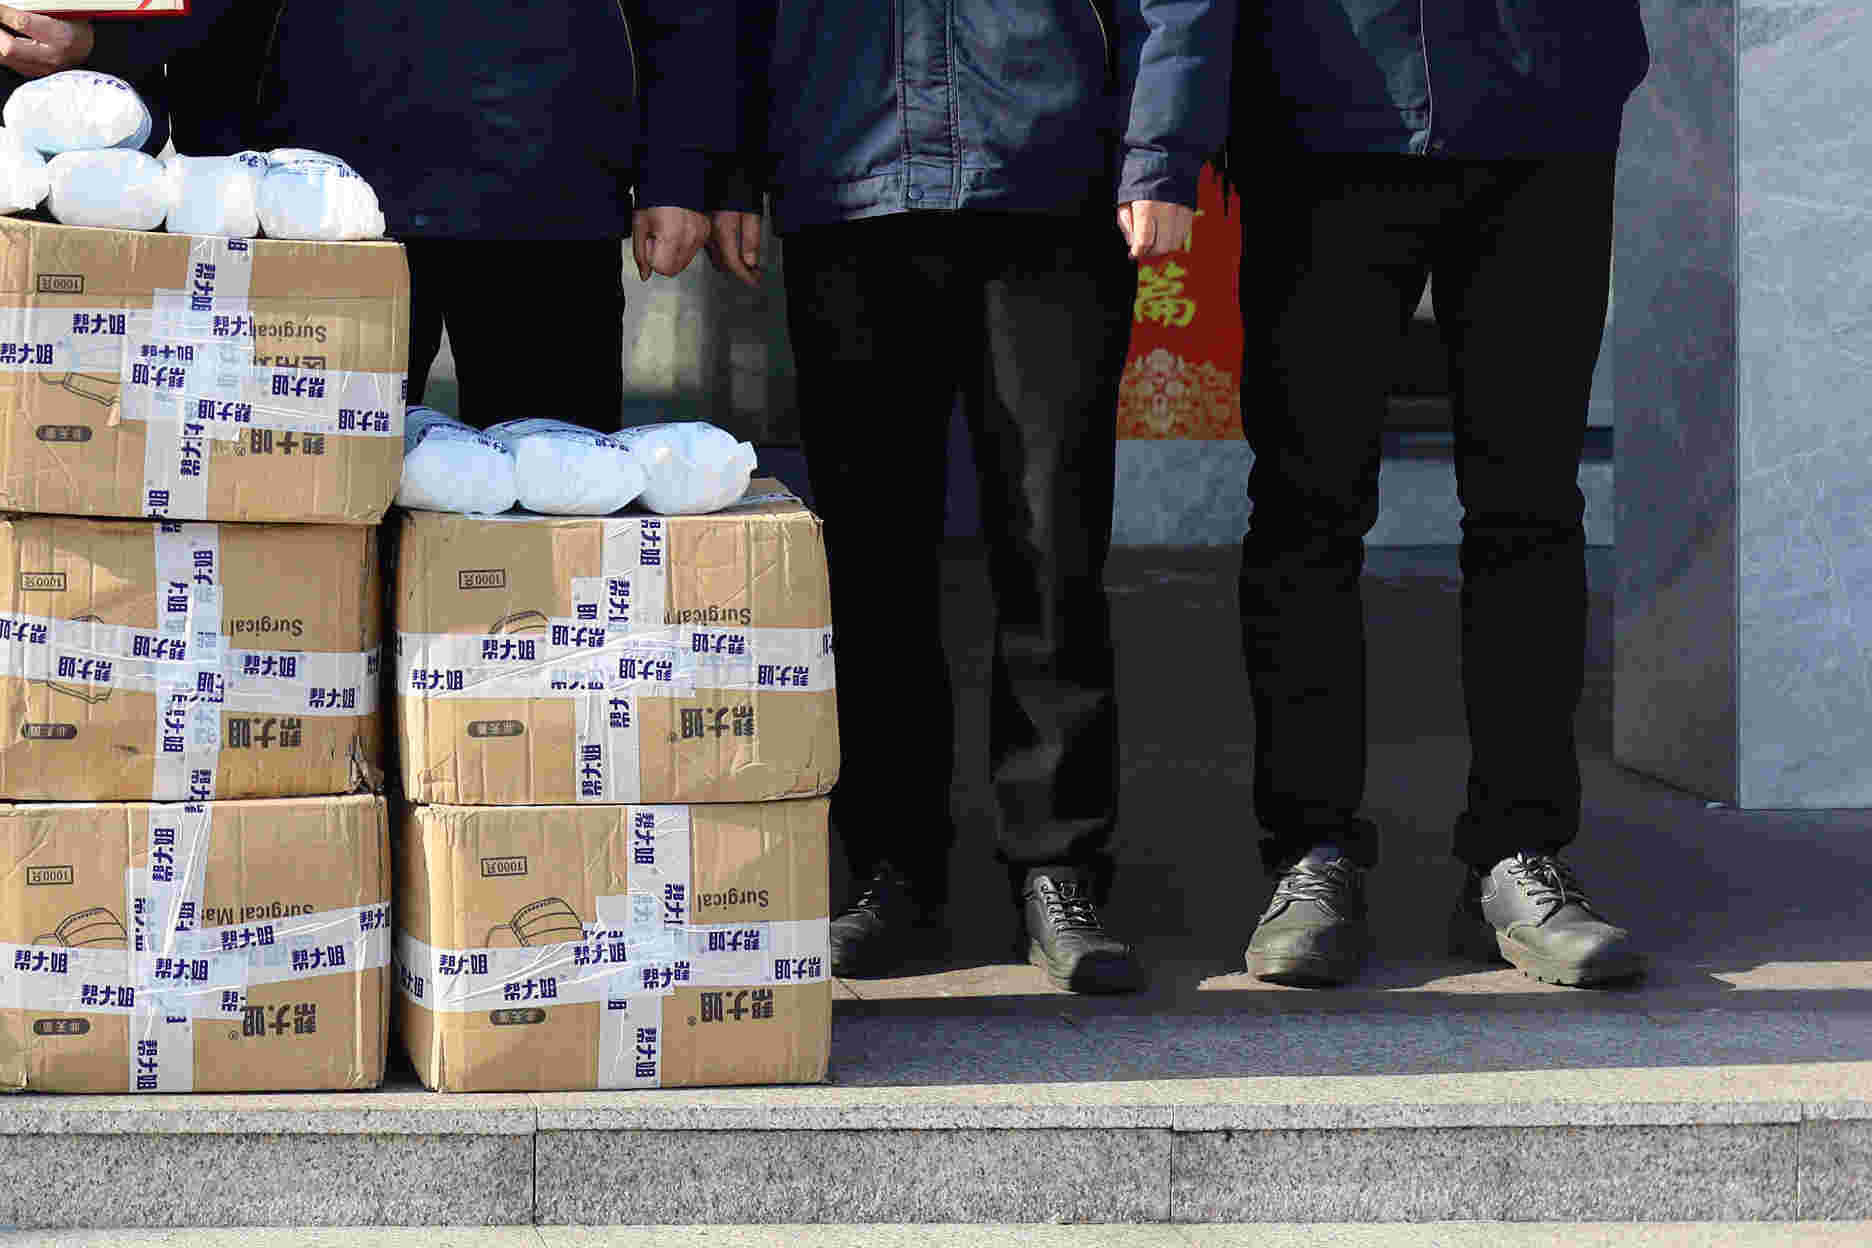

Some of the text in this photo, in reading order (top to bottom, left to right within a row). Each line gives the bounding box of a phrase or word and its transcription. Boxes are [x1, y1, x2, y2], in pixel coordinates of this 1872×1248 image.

[1133, 260, 1196, 328] 篇
[73, 314, 125, 335] 帮大姐
[0, 344, 53, 365] 帮大姐
[272, 374, 325, 397] 帮大姐
[198, 400, 252, 423] 帮大姐
[338, 409, 390, 432] 帮大姐
[681, 607, 751, 625] Surgical
[230, 618, 304, 637] Surgical
[482, 639, 535, 660] 帮大姐
[692, 633, 744, 654] 帮大姐
[58, 657, 112, 682] 帮大姐
[244, 656, 296, 677] 帮大姐
[153, 828, 175, 882] 帮大姐
[698, 889, 768, 910] Surgical
[221, 926, 274, 950] 帮大姐
[15, 950, 68, 974] 帮大姐
[292, 945, 345, 971] 帮大姐
[155, 959, 208, 981] 帮大姐
[81, 985, 135, 1007] 帮大姐
